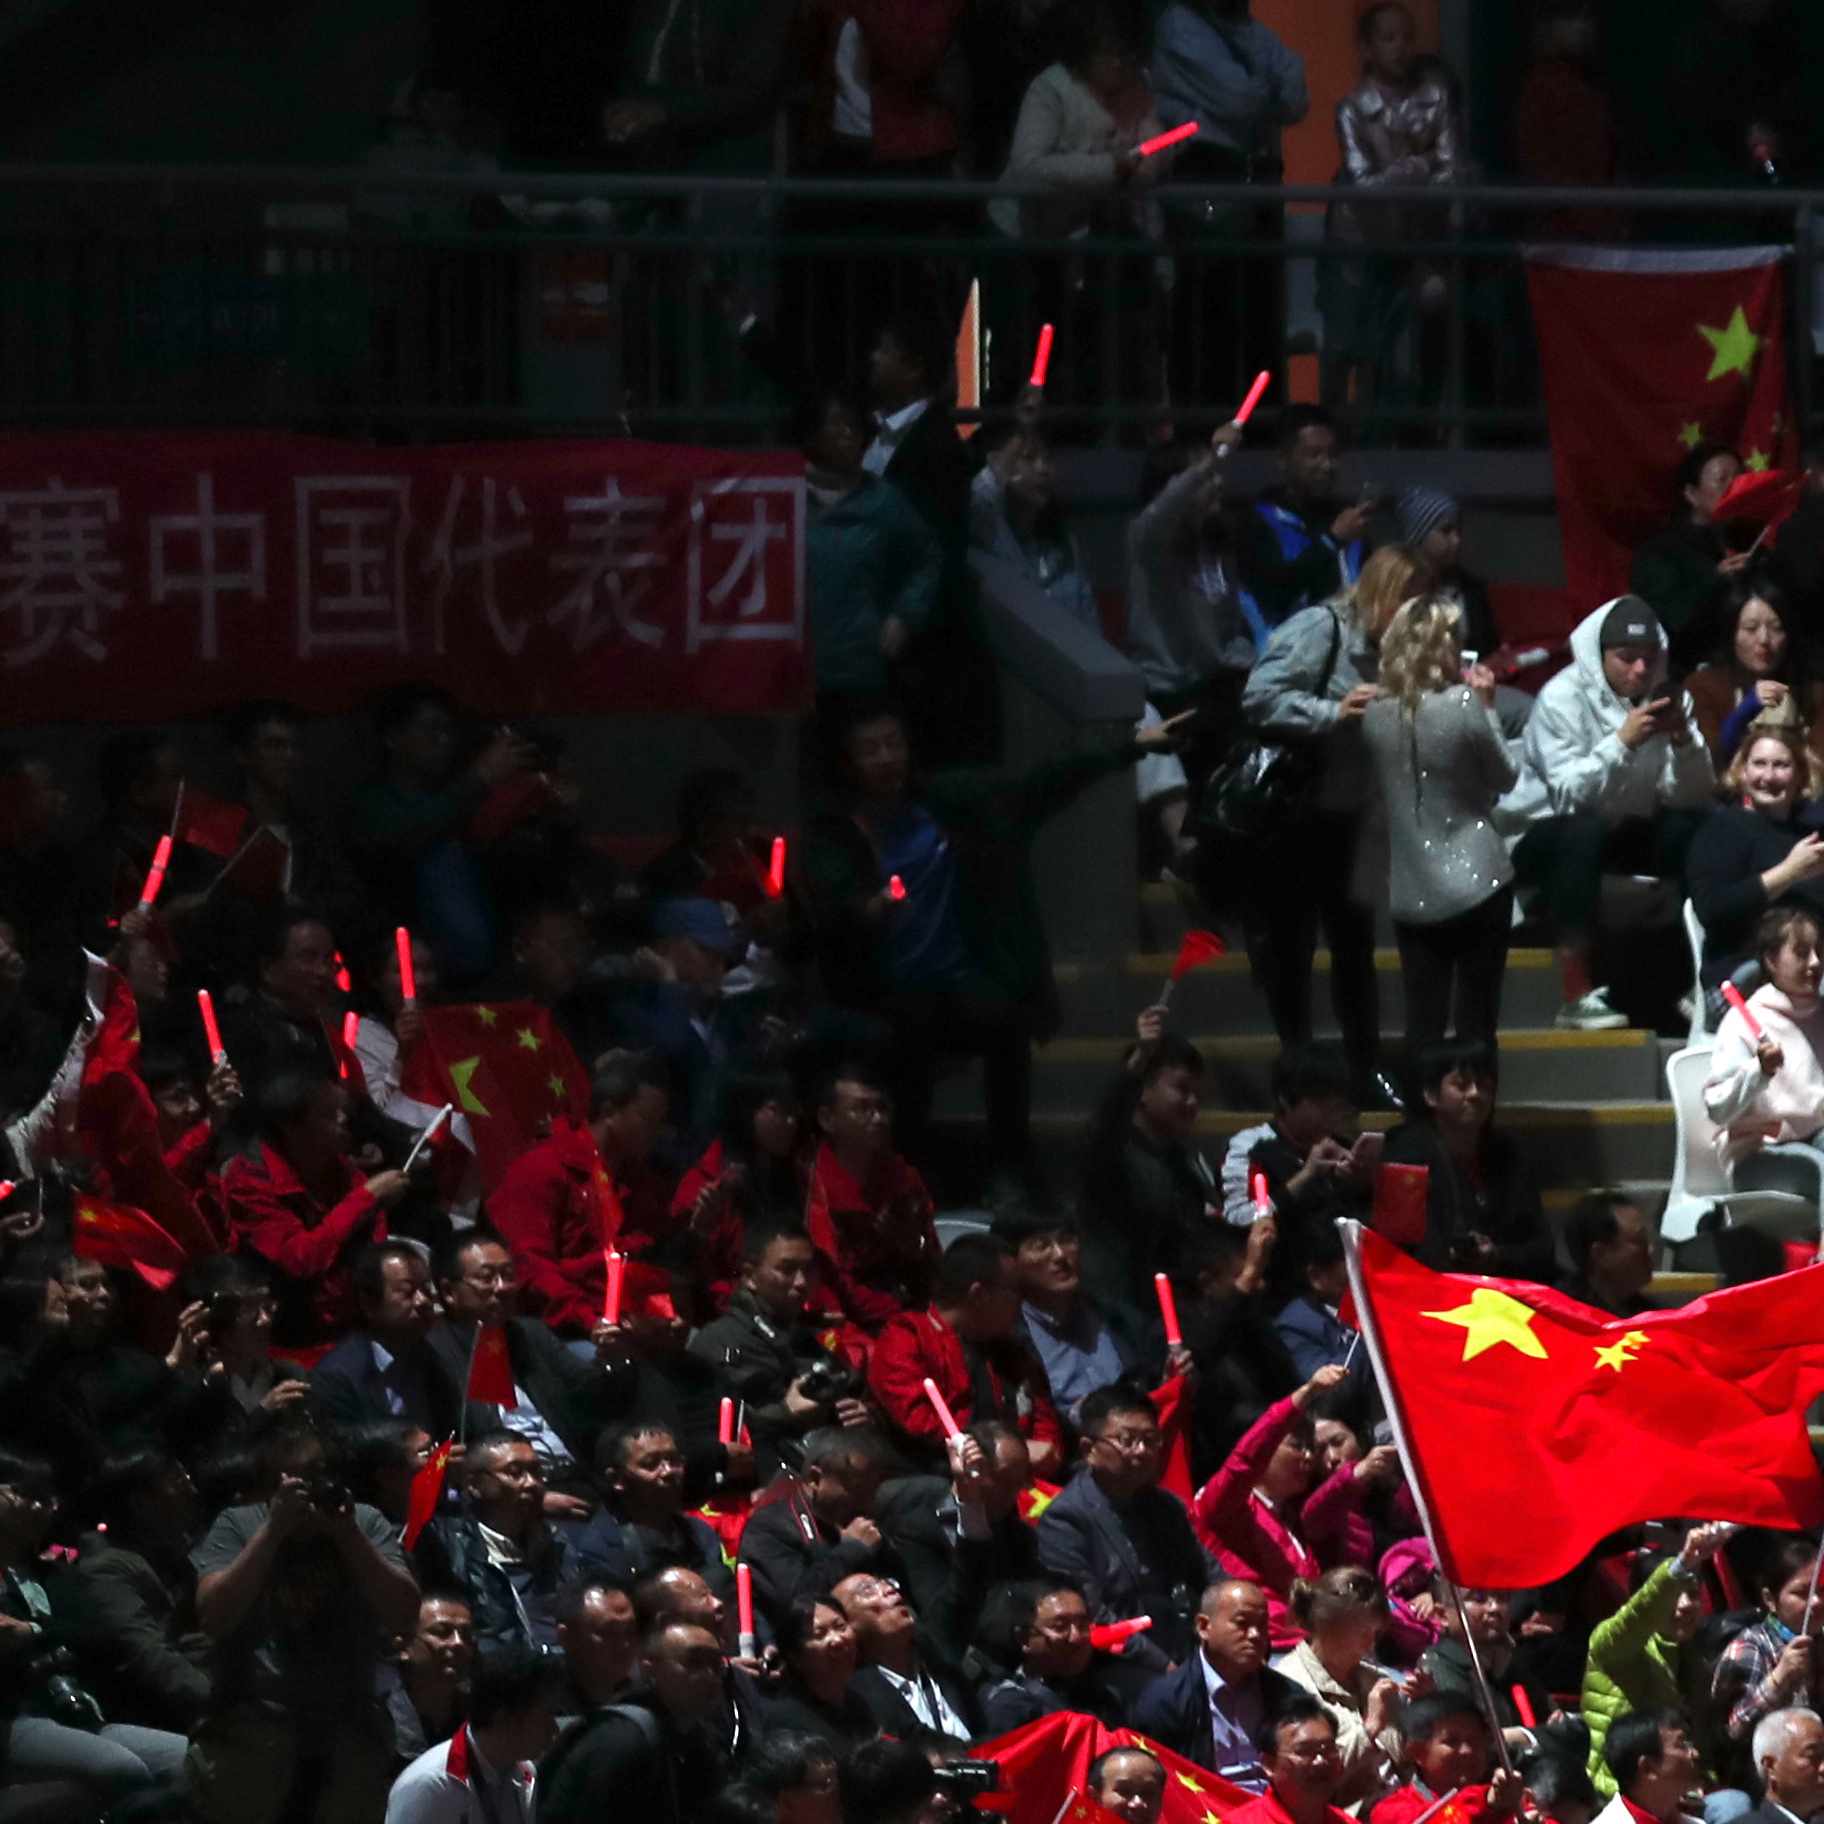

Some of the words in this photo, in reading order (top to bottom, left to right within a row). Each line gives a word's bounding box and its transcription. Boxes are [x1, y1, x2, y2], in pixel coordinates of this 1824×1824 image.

[0, 471, 807, 668] 赛中国代表团
